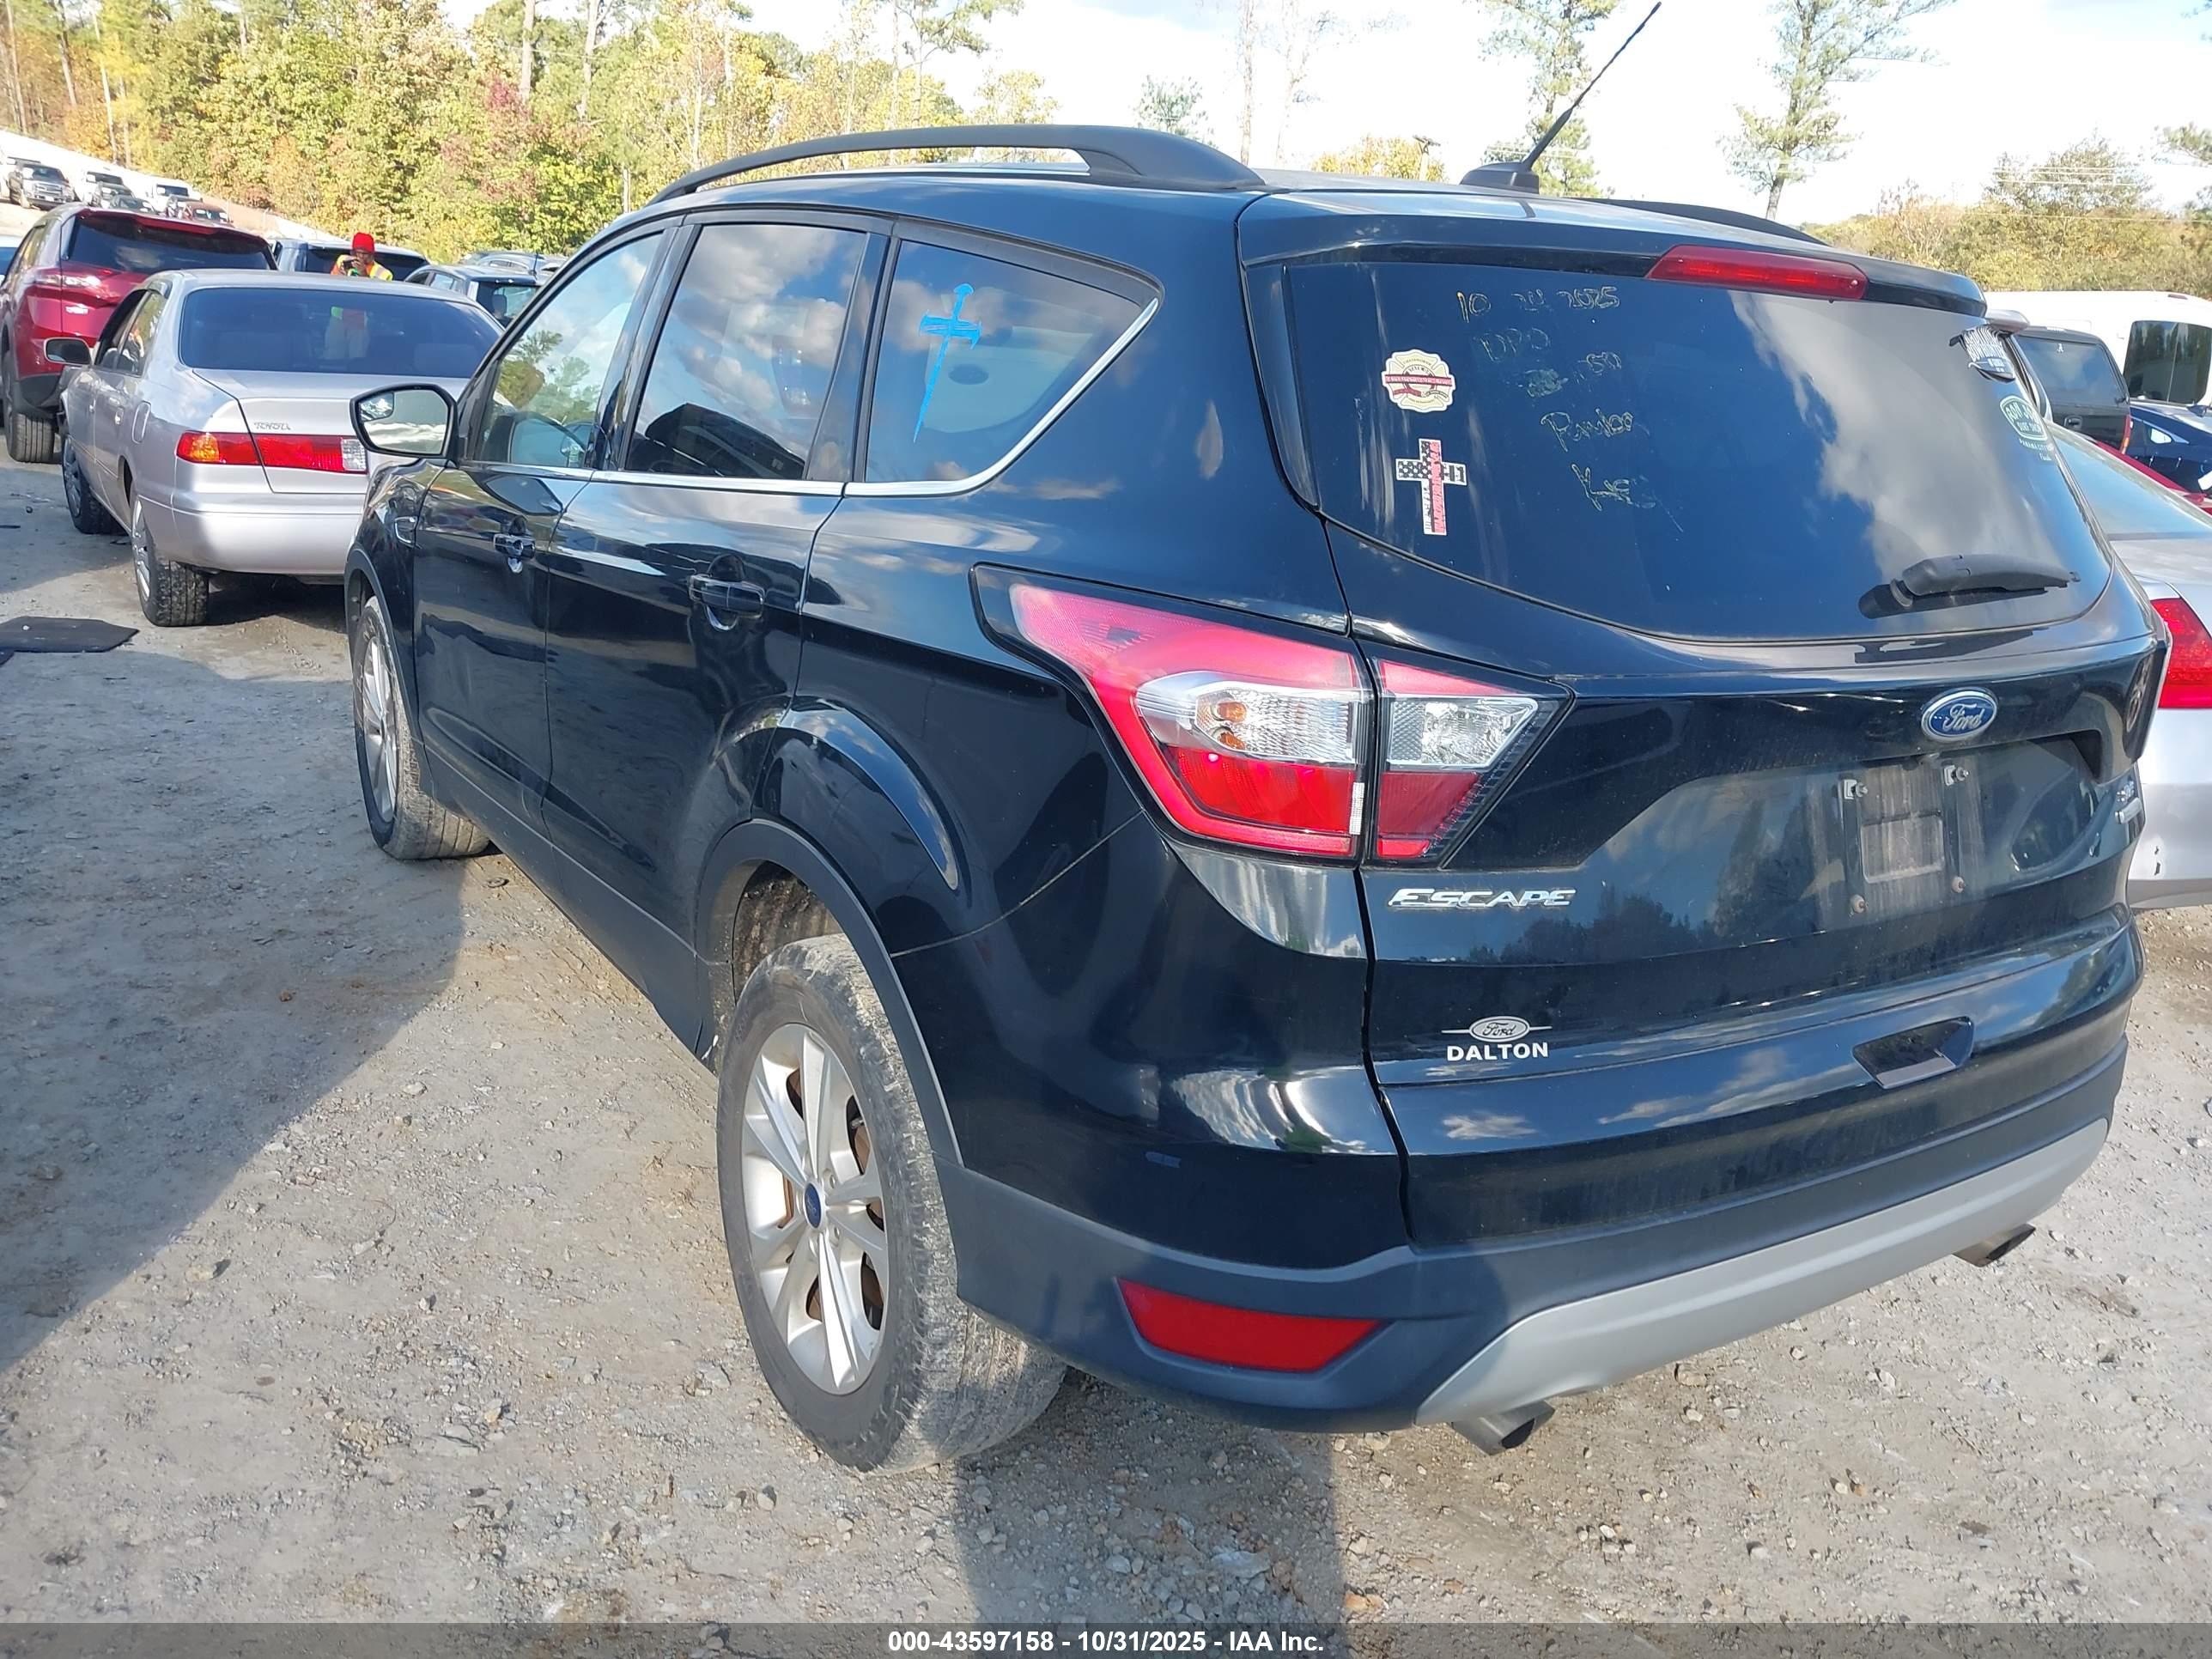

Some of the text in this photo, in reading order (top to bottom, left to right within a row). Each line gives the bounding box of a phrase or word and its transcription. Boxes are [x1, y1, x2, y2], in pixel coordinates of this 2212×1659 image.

[1942, 703, 1984, 731] Ford
[1388, 888, 1577, 908] ESCAPE
[1482, 1023, 1516, 1036] Ford
[1447, 1042, 1548, 1061] DALTON
